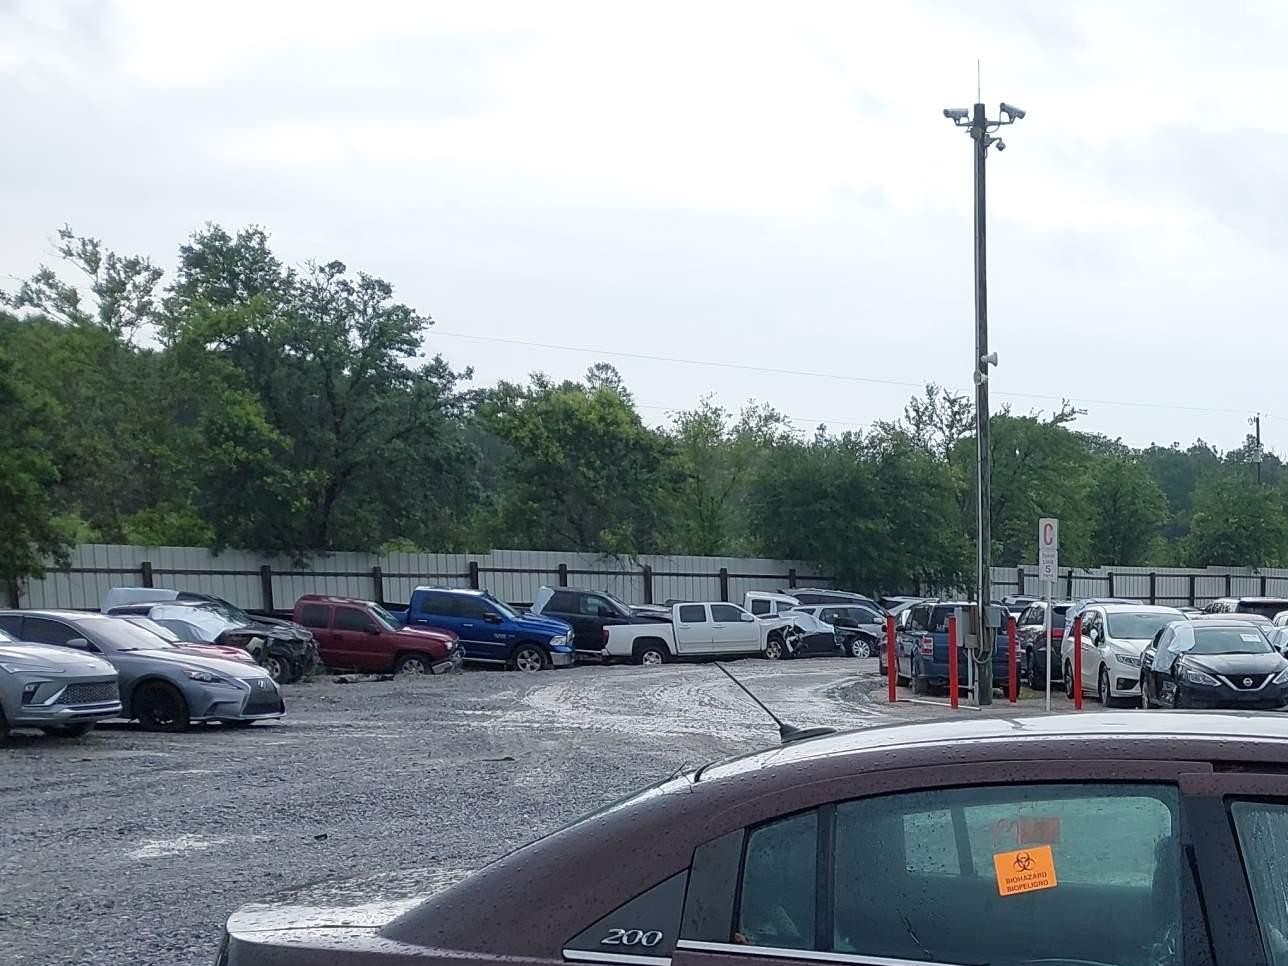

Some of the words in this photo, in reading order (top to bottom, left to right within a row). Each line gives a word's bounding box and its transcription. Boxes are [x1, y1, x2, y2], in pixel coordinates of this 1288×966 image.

[1043, 523, 1053, 546] C
[1045, 565, 1051, 573] 5
[1005, 871, 1047, 885] BIOHAZARD
[1006, 880, 1049, 893] BIOPELIGRO
[601, 928, 663, 946] 200
